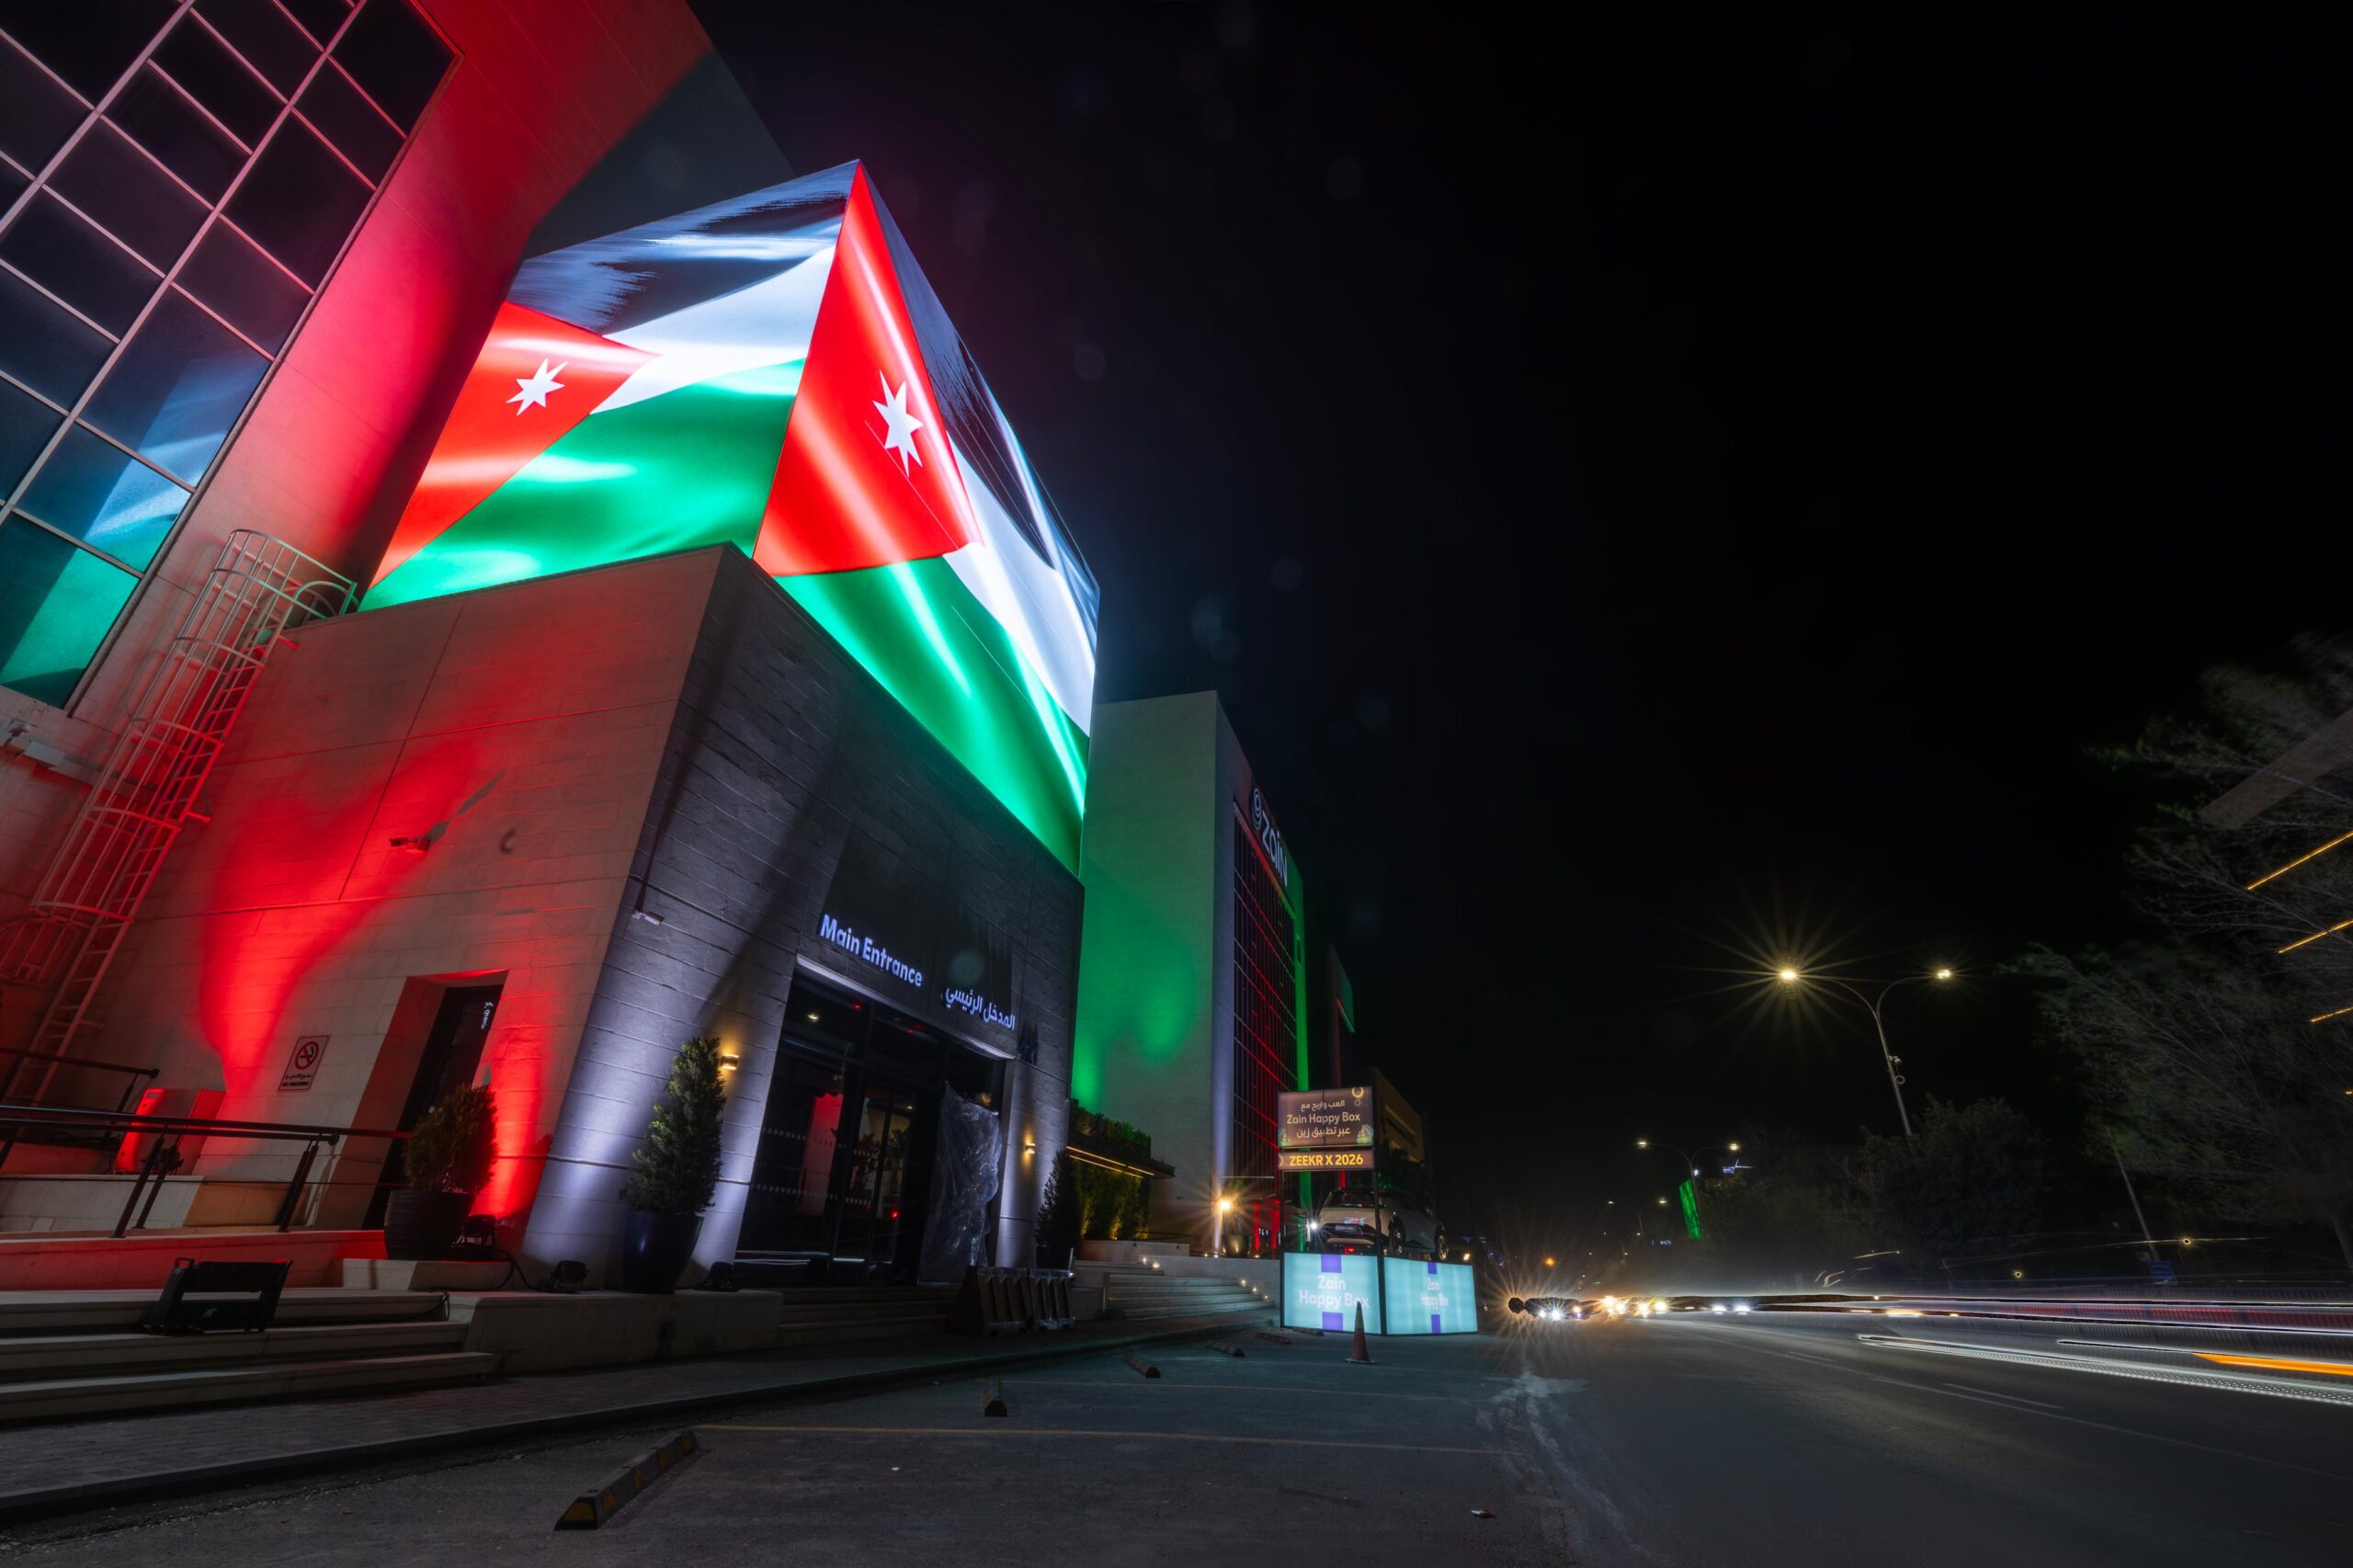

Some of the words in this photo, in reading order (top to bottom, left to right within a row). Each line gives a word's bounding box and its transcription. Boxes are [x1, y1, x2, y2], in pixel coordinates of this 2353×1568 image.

[820, 914, 859, 956] Main
[862, 936, 923, 987] Entrance
[945, 986, 983, 1016] الرئيسي
[983, 1002, 1016, 1030] المدخل
[1301, 1103, 1311, 1112] مع
[1287, 1114, 1307, 1124] Zain
[1309, 1113, 1340, 1125] Happy
[1342, 1111, 1360, 1121] Box
[1296, 1127, 1310, 1139] زين
[1312, 1126, 1336, 1138] تطبيق
[1337, 1127, 1351, 1137] عبر
[1289, 1154, 1324, 1166] ZEEKR
[1324, 1154, 1334, 1165] X
[1335, 1153, 1364, 1165] 2026
[1317, 1275, 1347, 1290] Zain
[1299, 1290, 1342, 1309] Happy
[1344, 1292, 1370, 1307] Box
